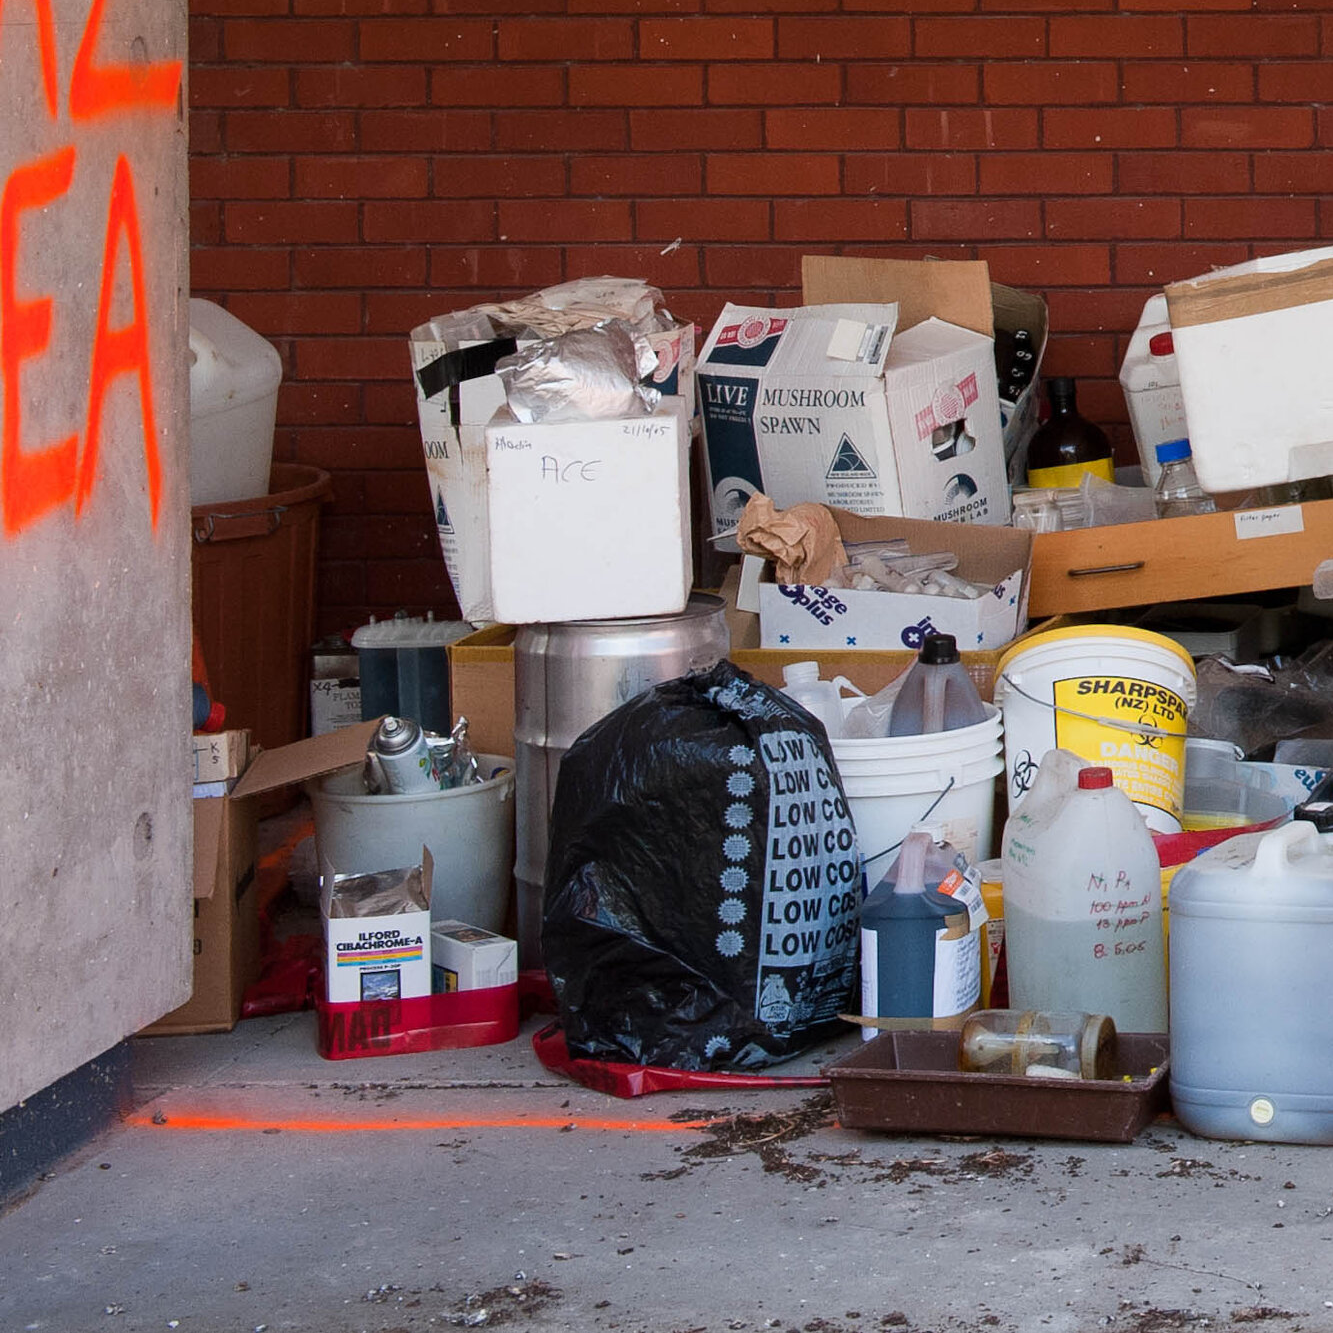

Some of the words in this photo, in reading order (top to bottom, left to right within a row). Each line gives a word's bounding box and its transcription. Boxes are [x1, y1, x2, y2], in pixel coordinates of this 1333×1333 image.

[706, 382, 749, 405] LIVE
[762, 388, 866, 408] MUSHROOM
[760, 416, 821, 435] SPAWN
[541, 455, 602, 484] ACE
[934, 497, 988, 522] MUSHROOM
[970, 507, 989, 520] LAB
[791, 594, 835, 626] plus
[1115, 697, 1149, 713] (NZ)
[1153, 705, 1175, 721] LTD
[822, 797, 847, 820] CO
[771, 831, 819, 860] LOW
[824, 827, 852, 851] CO
[769, 865, 821, 892] LOW
[766, 897, 821, 924] LOW
[828, 890, 861, 916] COS
[336, 936, 423, 951] CIBACHROME-A
[358, 929, 400, 941] ILFORD
[765, 929, 819, 956] LOW
